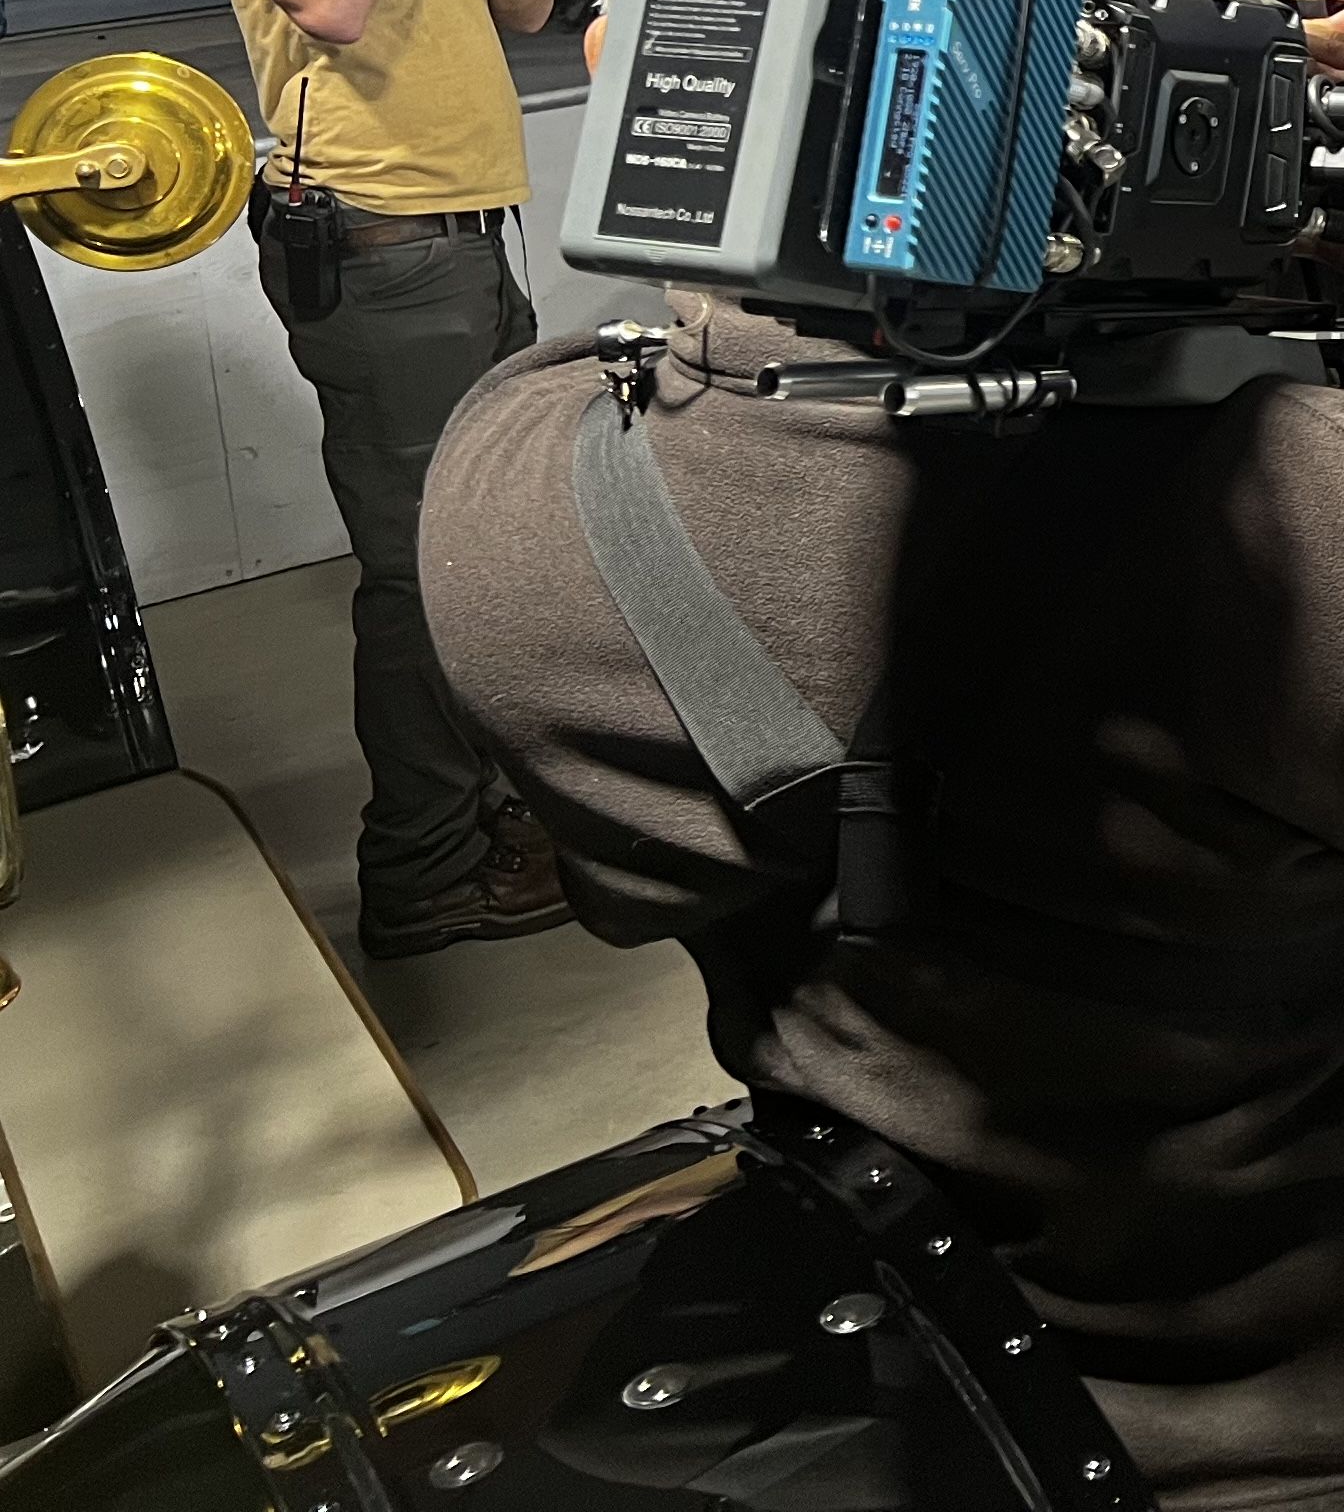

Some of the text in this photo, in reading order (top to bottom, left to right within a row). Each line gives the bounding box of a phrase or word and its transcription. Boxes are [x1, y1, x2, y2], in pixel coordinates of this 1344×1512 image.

[645, 72, 736, 98] High Quality
[968, 73, 982, 99] Pro
